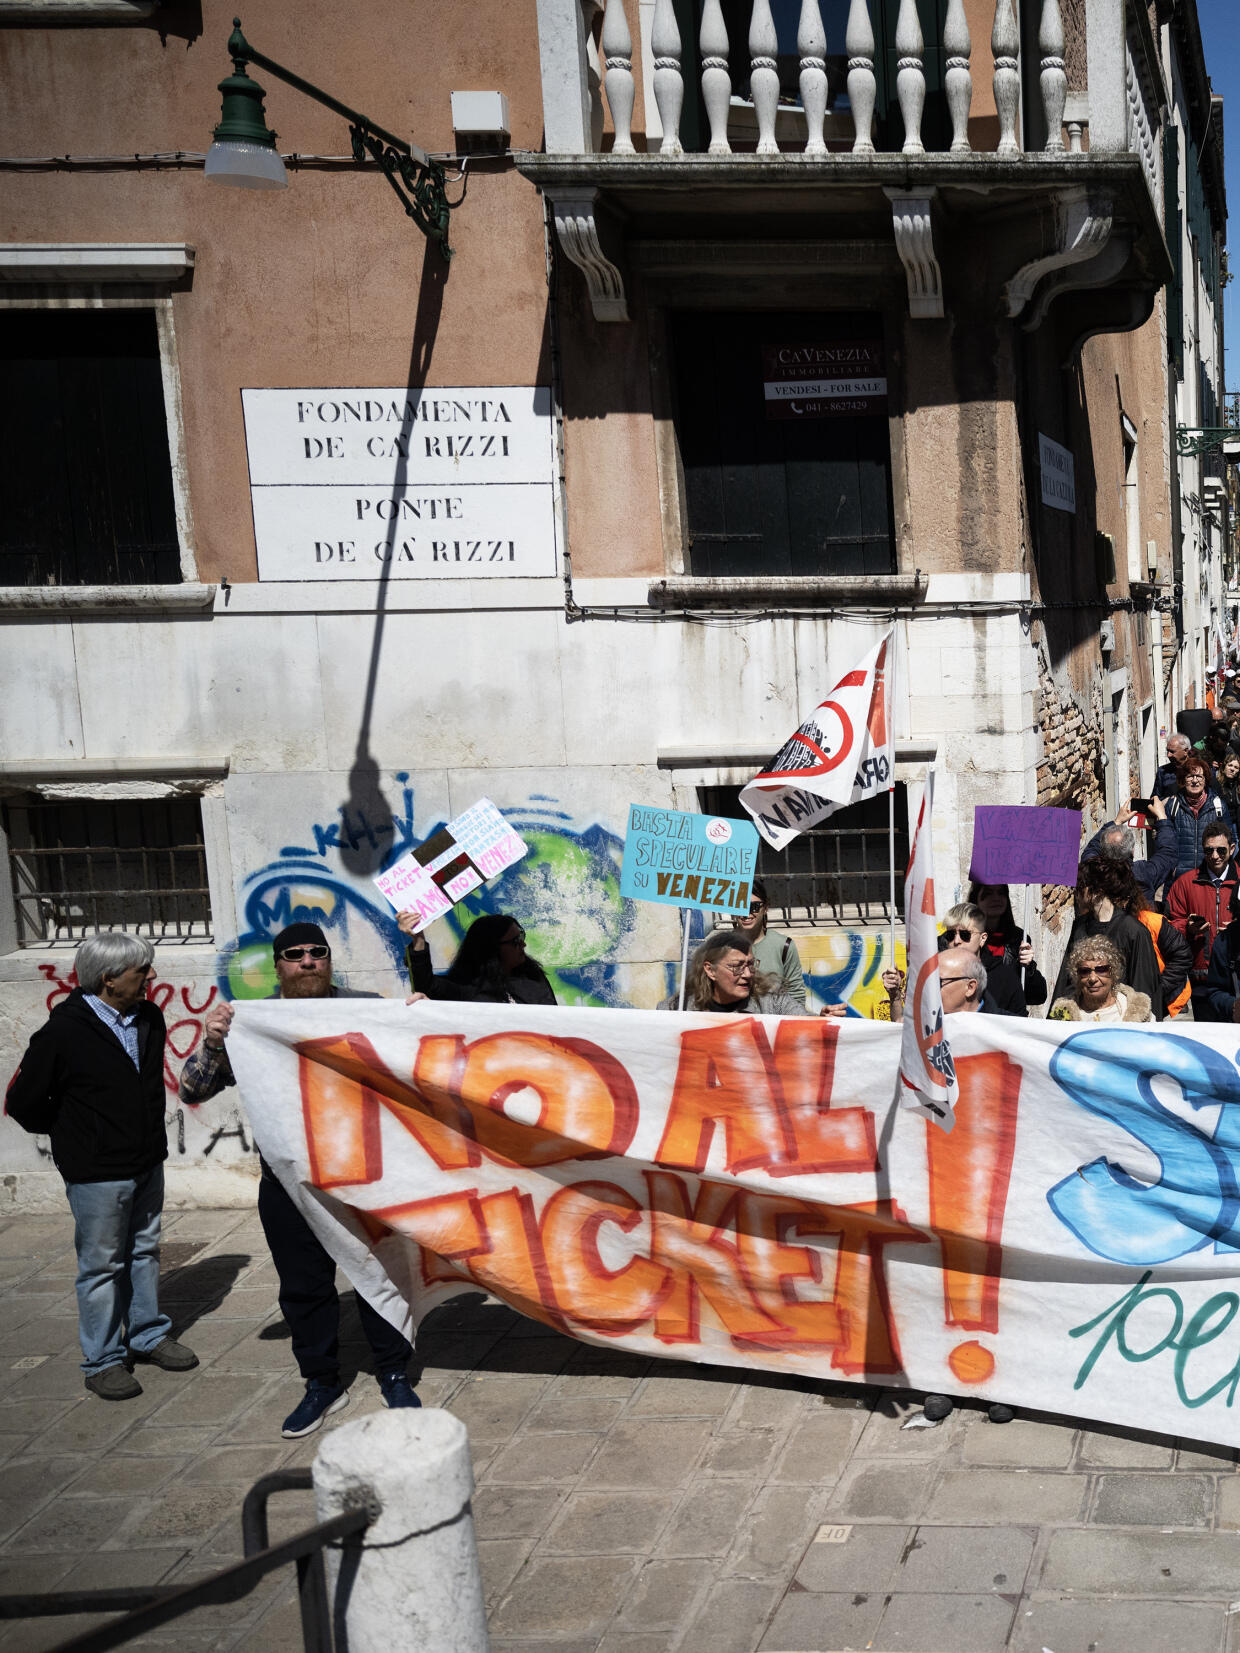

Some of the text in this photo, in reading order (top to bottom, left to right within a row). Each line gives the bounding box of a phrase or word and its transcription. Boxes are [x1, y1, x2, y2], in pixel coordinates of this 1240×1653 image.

[775, 385, 821, 395] VENDESI
[830, 384, 851, 393] FOR
[854, 383, 881, 392] SALE
[297, 401, 512, 423] FONDAMENTA
[304, 436, 345, 459] DE
[424, 435, 511, 458] RIZZI
[355, 498, 464, 520] PONTE
[314, 540, 356, 563] DE
[431, 540, 516, 562] RIZZI
[632, 809, 693, 840] BASTA
[636, 837, 752, 874] SPECULARE
[384, 867, 421, 897] TICKET
[391, 864, 405, 877] AL
[634, 872, 648, 888] SU
[297, 1018, 878, 1190] NO AL
